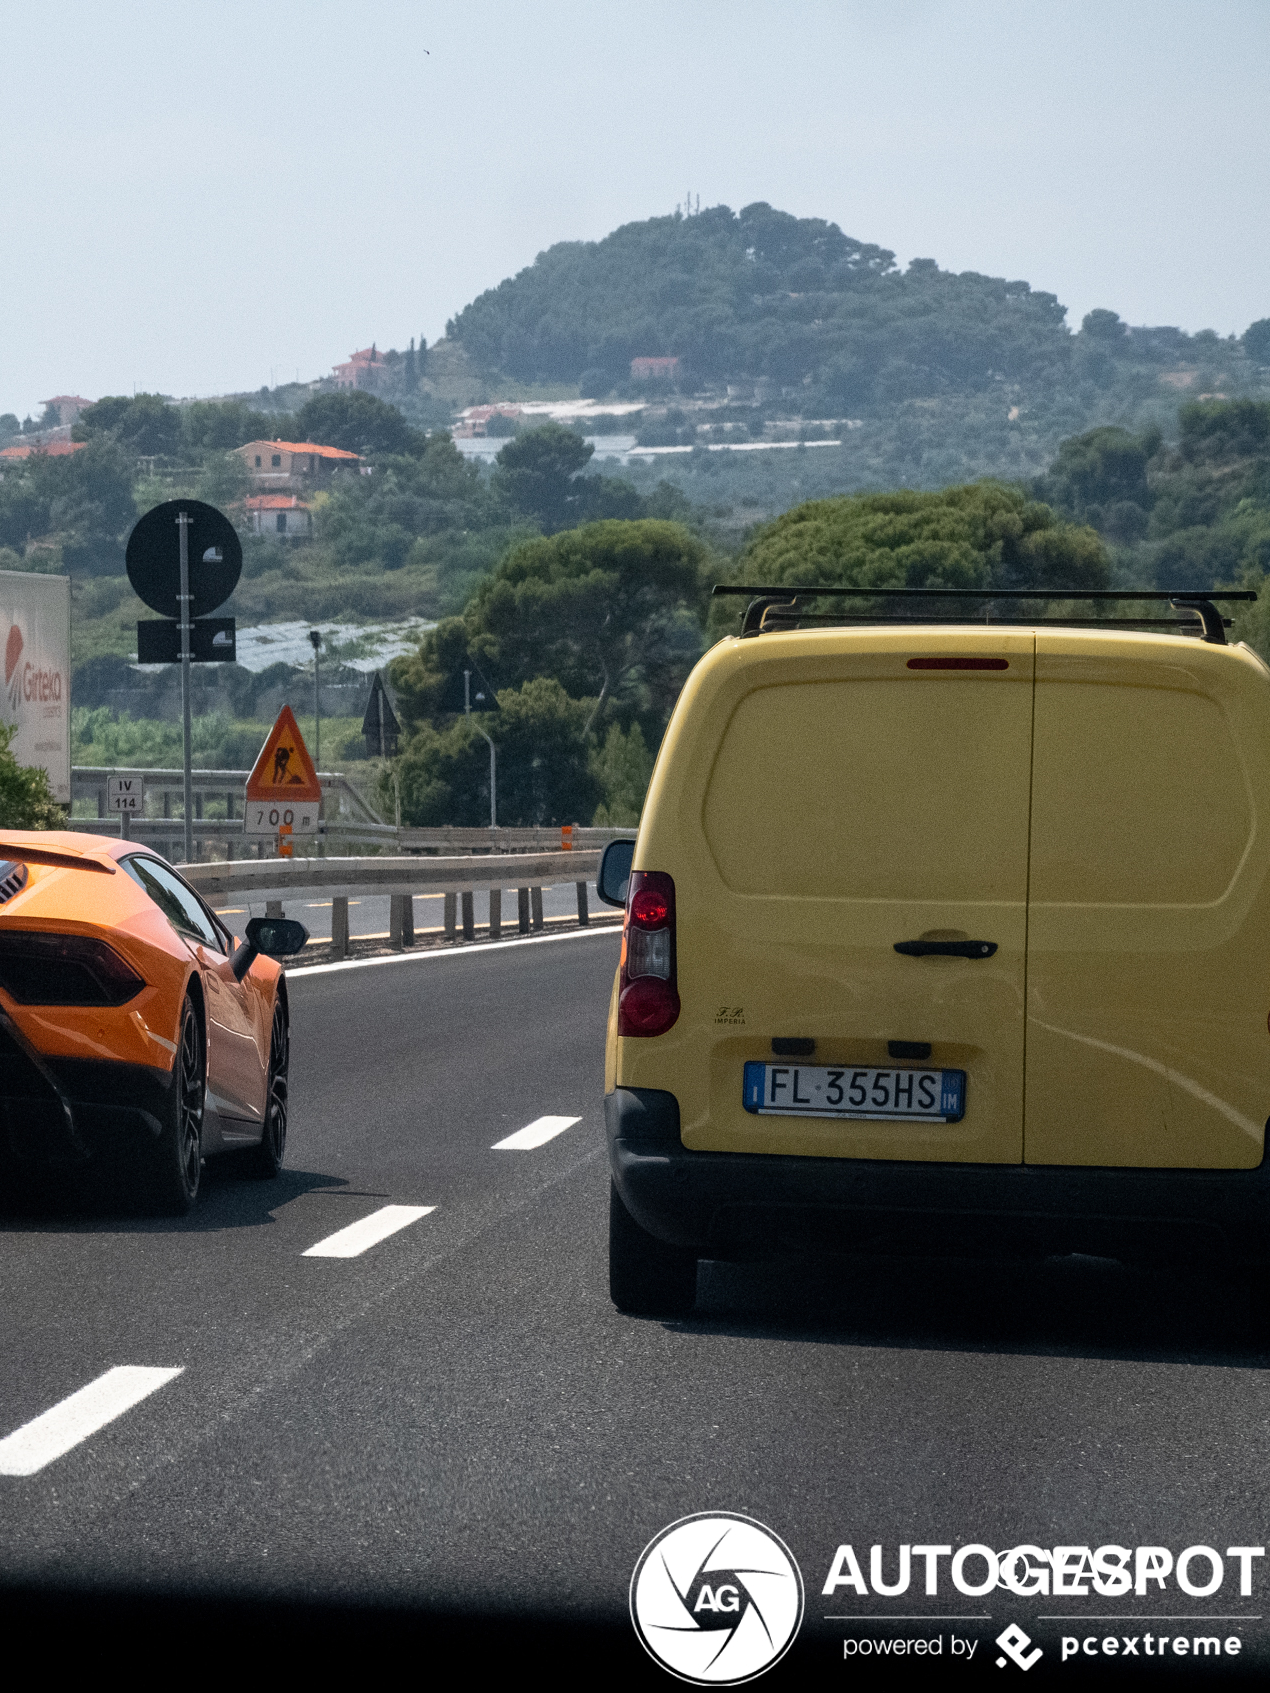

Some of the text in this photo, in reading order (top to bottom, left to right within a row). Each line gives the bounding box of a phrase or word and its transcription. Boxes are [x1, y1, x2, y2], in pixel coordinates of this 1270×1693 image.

[119, 780, 132, 791] IV
[115, 797, 136, 809] 114
[257, 808, 294, 826] 700
[770, 1068, 937, 1110] FL 355HS
